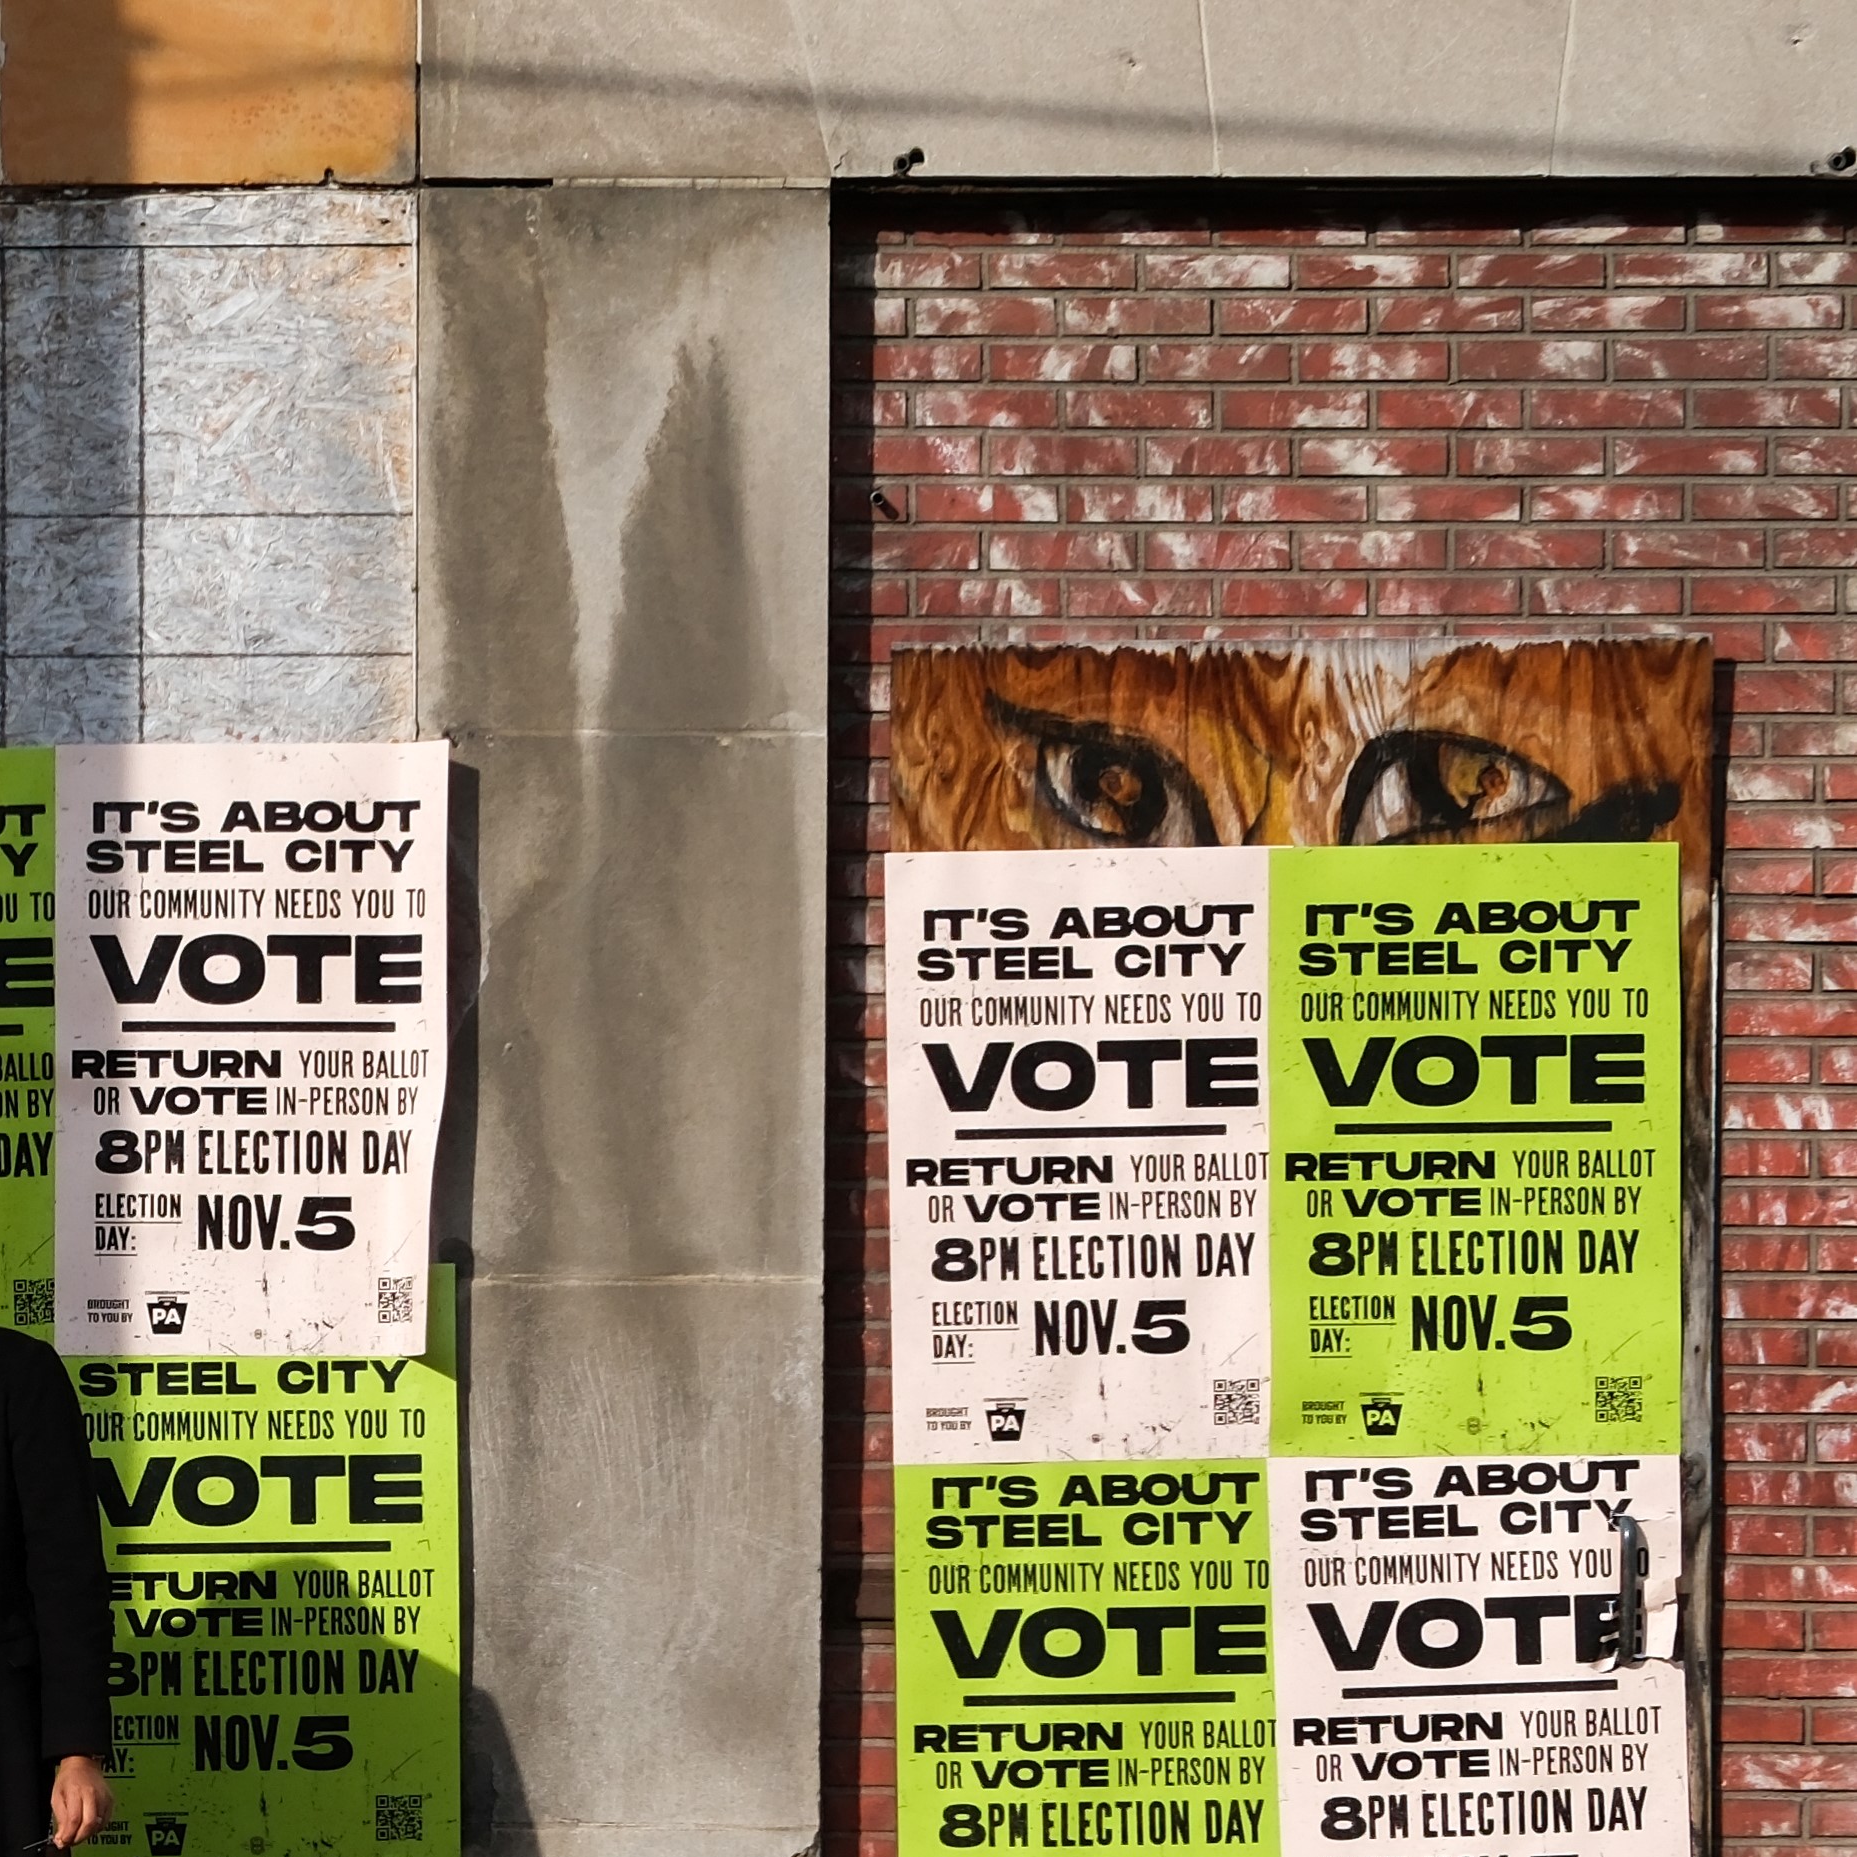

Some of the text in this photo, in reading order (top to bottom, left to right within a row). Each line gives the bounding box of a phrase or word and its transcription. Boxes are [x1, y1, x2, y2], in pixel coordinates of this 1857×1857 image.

[924, 904, 1254, 941] IT'S ABOUT
[922, 1038, 1258, 1112] VOTE
[1286, 1149, 1655, 1181] RETURN YOUR BALLOT
[87, 1299, 130, 1309] BROUGHT
[87, 1312, 133, 1323] TO YOU BY
[152, 1307, 181, 1325] PA
[932, 1301, 1017, 1326] ELECTION
[1412, 1295, 1572, 1351] NOV.5
[933, 1334, 975, 1358] DAY:
[80, 1361, 409, 1395] STEEL CITY
[1305, 1460, 1639, 1502] IT'S ABOUT
[926, 1511, 1252, 1549] STEEL CITY
[195, 1715, 353, 1771] NOV.5
[1316, 1743, 1648, 1782] OR VOTE IN-PERSON BY
[151, 1830, 180, 1846] PA
[939, 1800, 1264, 1847] 8PM ELECTION DAY
